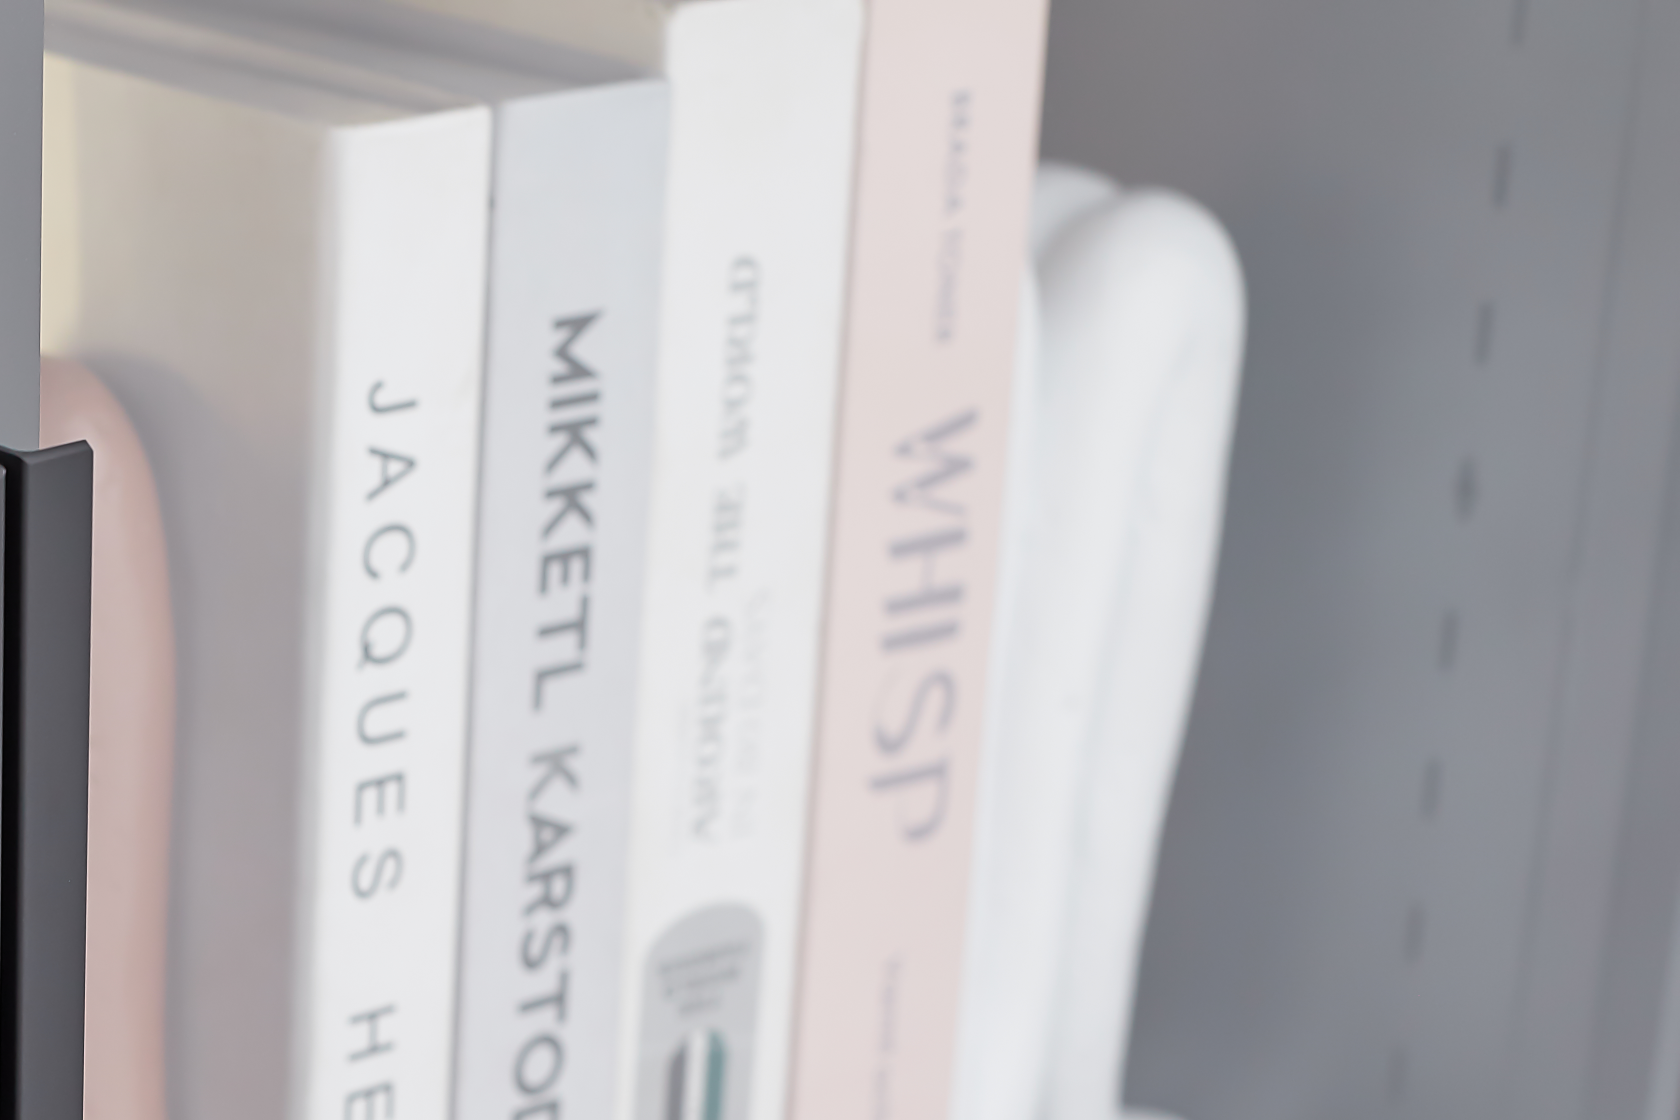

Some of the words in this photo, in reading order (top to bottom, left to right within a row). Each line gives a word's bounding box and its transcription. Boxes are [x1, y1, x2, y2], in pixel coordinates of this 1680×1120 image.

[349, 380, 419, 902] JACQUES
[531, 309, 603, 713] MIKKETL
[869, 408, 980, 844] WHISP
